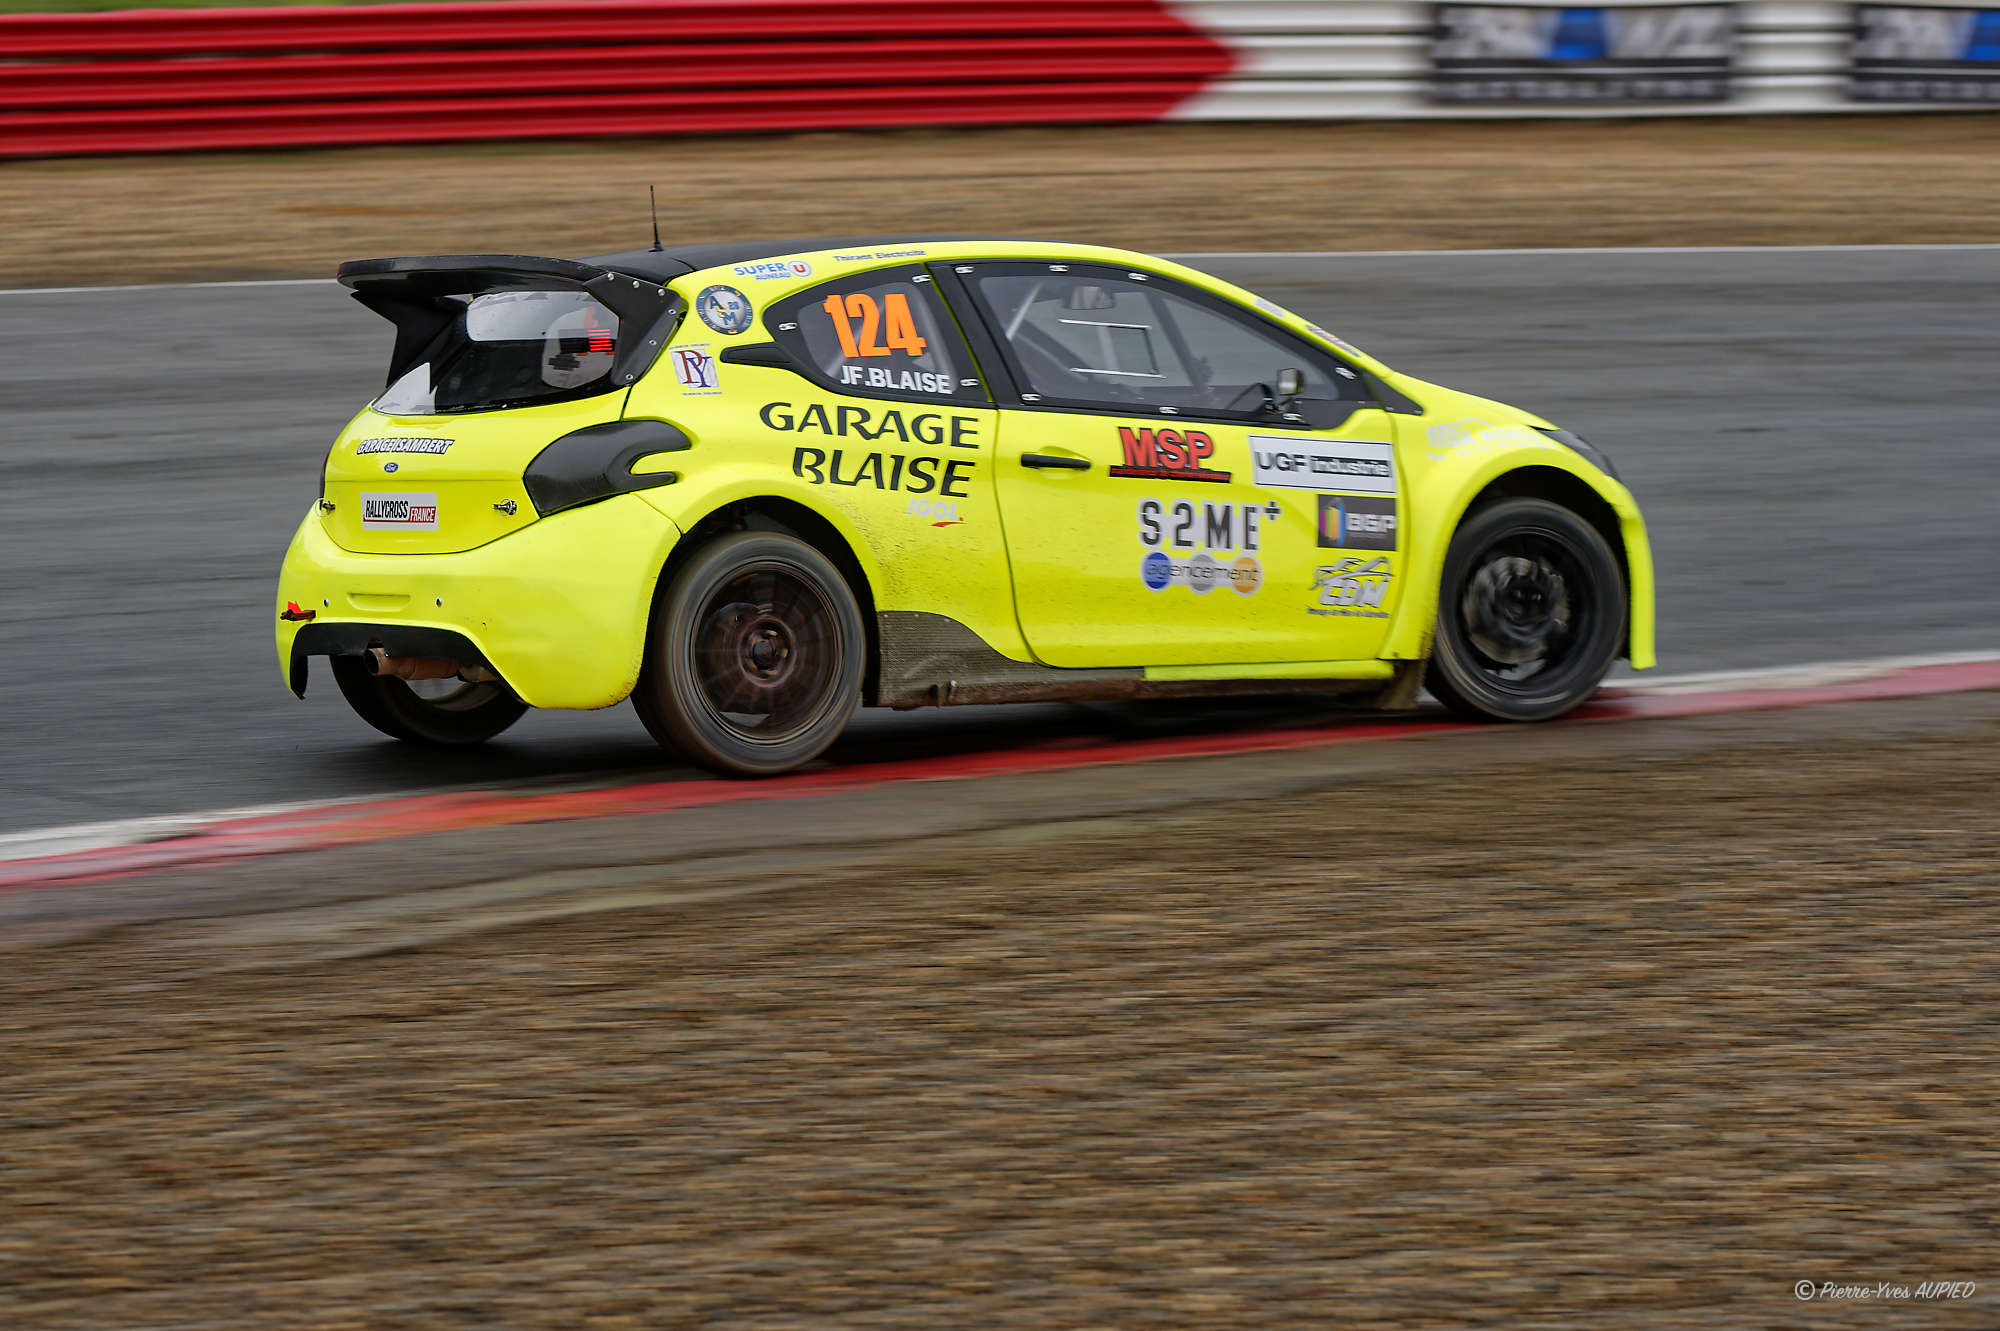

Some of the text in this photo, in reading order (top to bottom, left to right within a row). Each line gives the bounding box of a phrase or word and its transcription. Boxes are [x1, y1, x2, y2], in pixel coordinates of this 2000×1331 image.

[734, 262, 806, 276] SUPER U
[823, 293, 927, 358] 124
[841, 365, 953, 394] JF.BLAISE
[760, 402, 979, 449] GARAGE
[357, 437, 455, 454] GARAGE ISAMBERT
[1118, 426, 1214, 470] MSP
[793, 447, 976, 498] BLAISE
[1255, 451, 1391, 477] UGF industrie
[365, 500, 435, 521] RALLYCROSS FRANCE
[906, 498, 958, 521] IGOL
